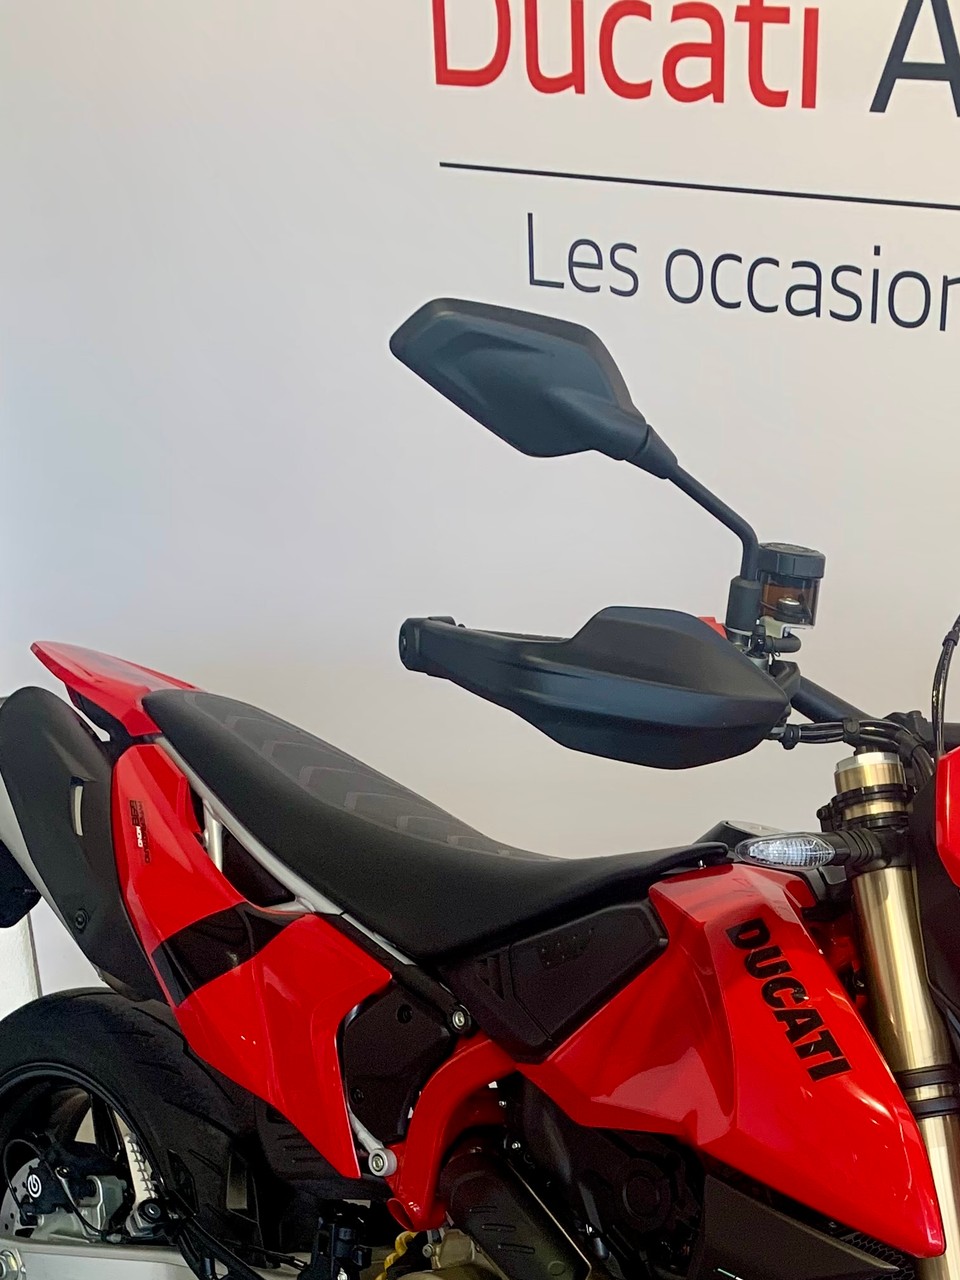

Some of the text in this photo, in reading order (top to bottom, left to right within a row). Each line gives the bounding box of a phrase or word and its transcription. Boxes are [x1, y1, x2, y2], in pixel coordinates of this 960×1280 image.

[431, 0, 820, 110] Ducati
[527, 212, 640, 298] Les
[725, 918, 852, 1082] DUCATI
